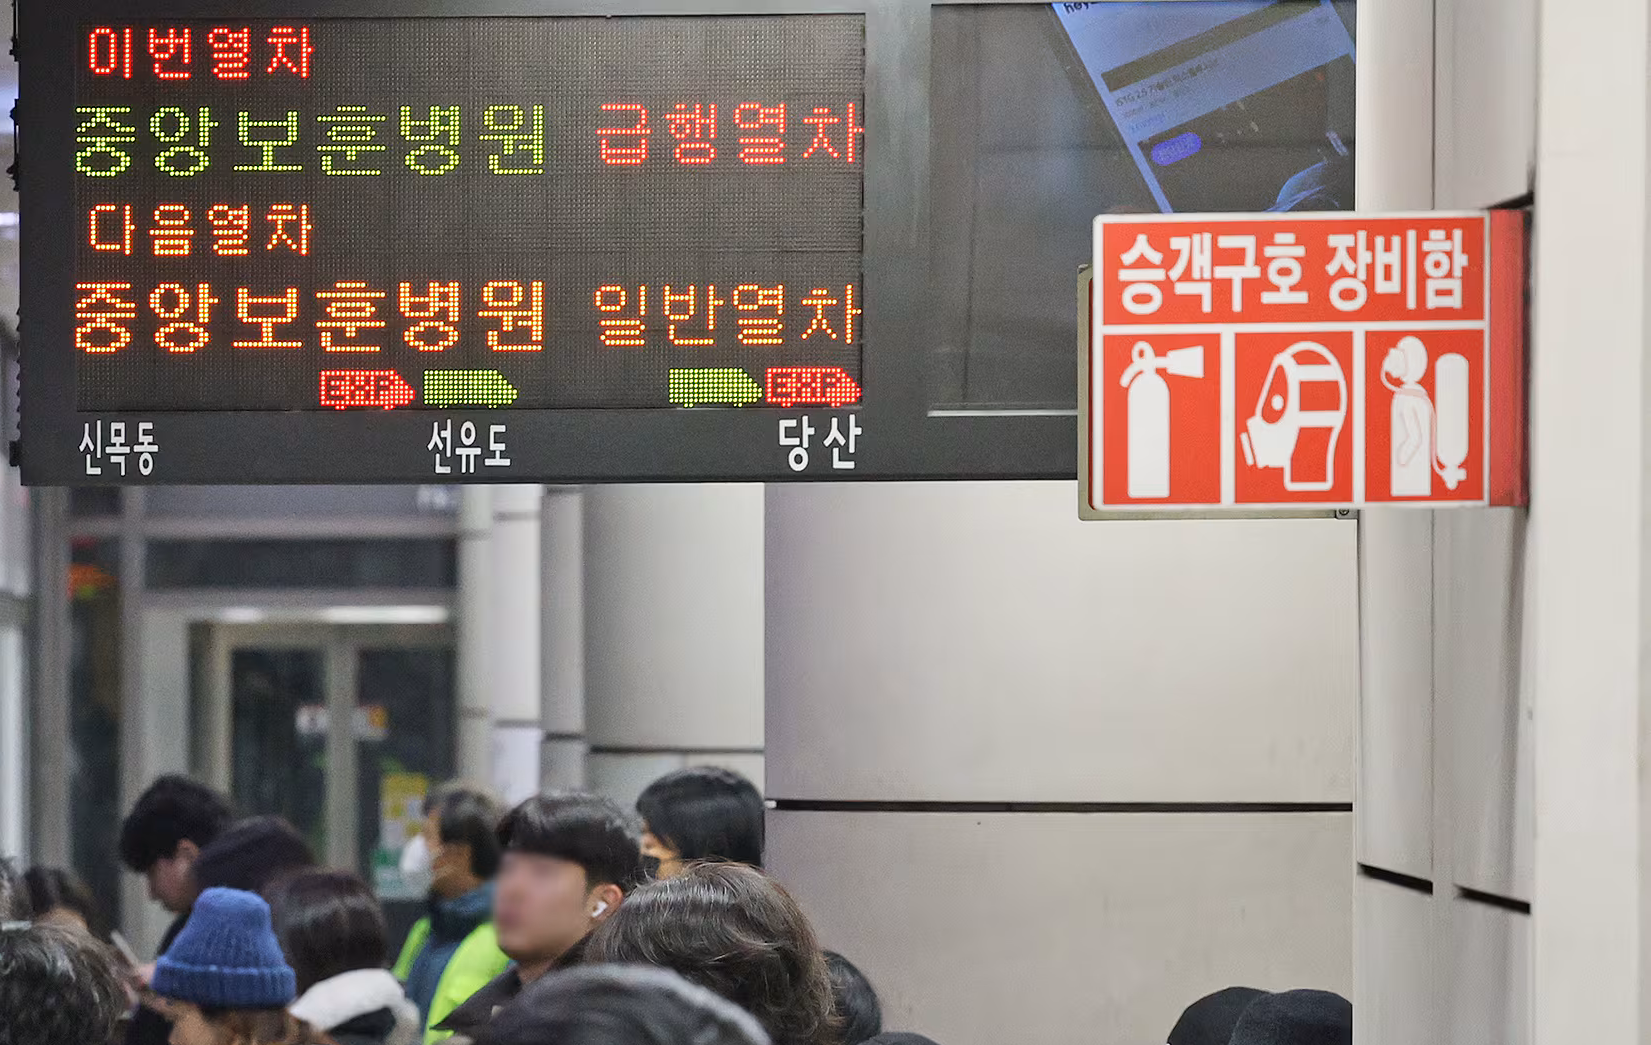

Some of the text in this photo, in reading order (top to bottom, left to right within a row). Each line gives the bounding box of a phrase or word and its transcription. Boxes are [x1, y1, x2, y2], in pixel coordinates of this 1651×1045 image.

[88, 26, 314, 80] 이번열차
[75, 101, 863, 177] 중앙보훈병원 급행열차
[88, 203, 314, 257] 다음열차
[1117, 228, 1469, 315] 승객구호 장비함
[74, 280, 863, 353] 중앙보훈병원 일반열차
[79, 420, 160, 476] 신목동
[427, 418, 512, 474] 선유도
[777, 413, 863, 472] 당산
